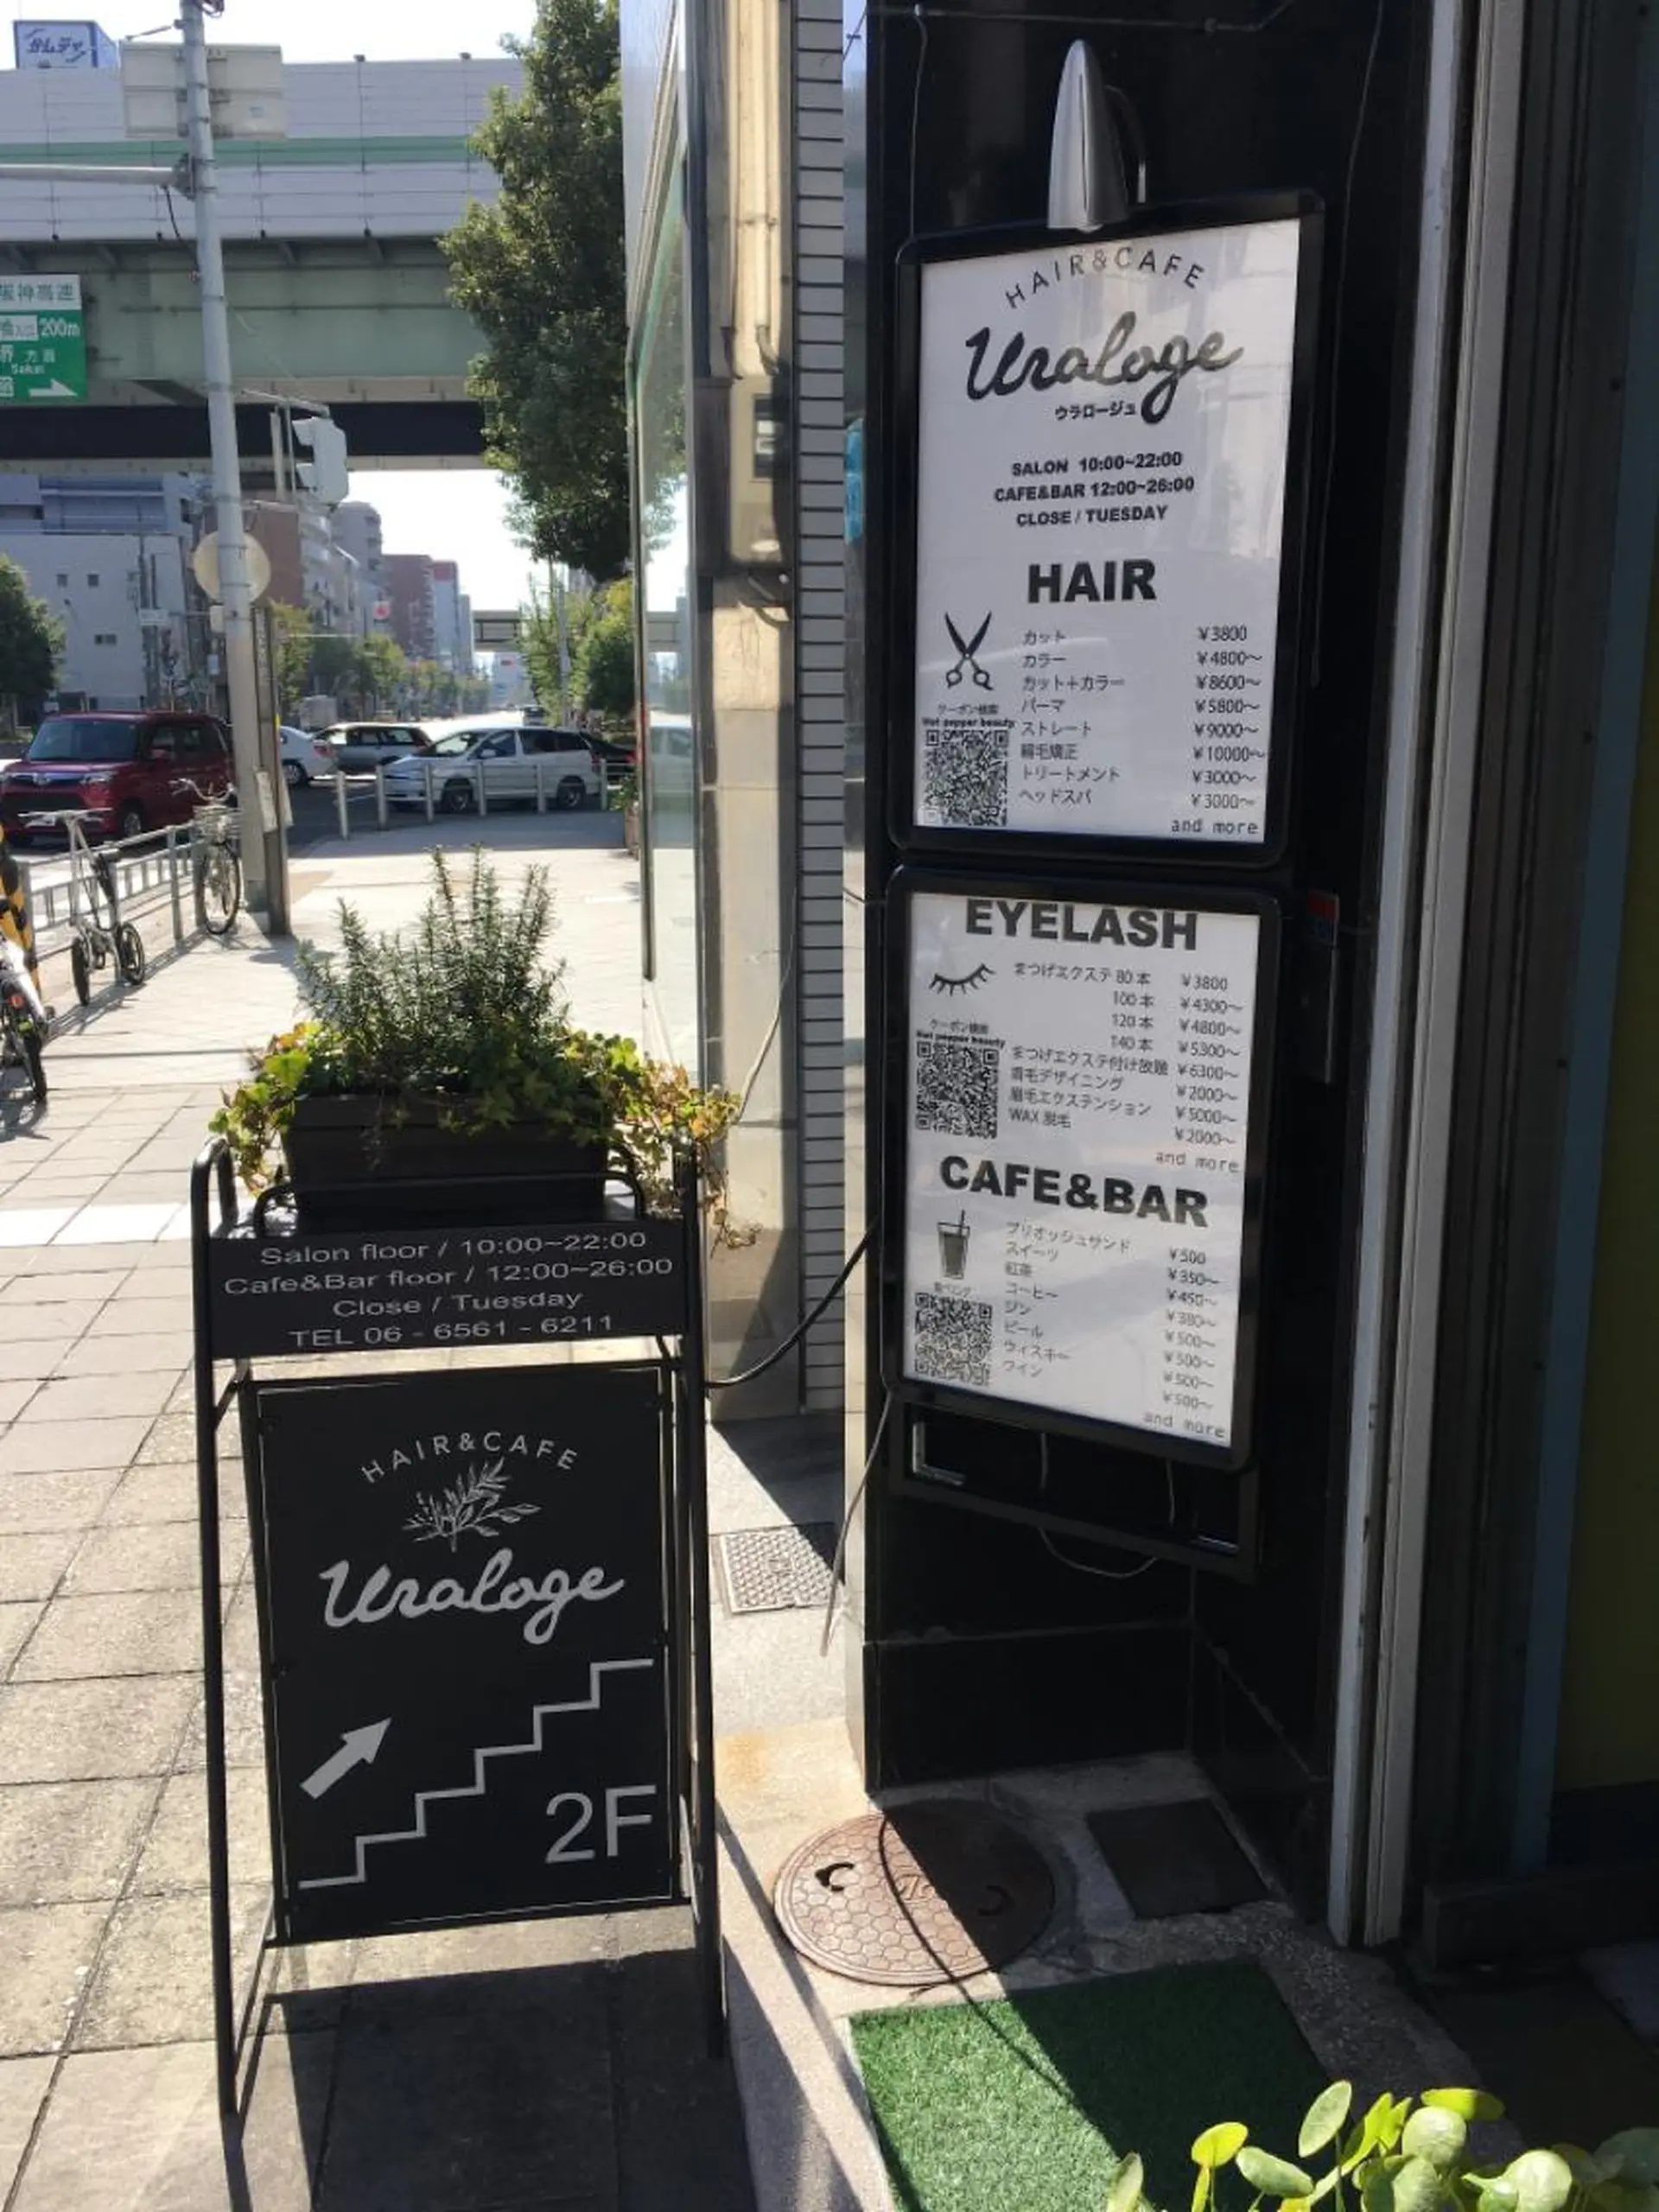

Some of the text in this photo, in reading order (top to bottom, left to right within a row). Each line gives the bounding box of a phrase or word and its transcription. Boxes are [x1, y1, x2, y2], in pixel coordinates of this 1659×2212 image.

[1004, 245, 1205, 309] HAIR&CAFE
[39, 317, 80, 337] 200m
[965, 310, 1244, 424] Uraloge
[1055, 401, 1136, 421] ウラロージュ
[1012, 452, 1183, 476] SALON 10:00~22:00
[994, 477, 1194, 502] CAFE&BAR 12:00~26:00
[1016, 510, 1071, 527] CLOSE
[1085, 505, 1169, 523] TUESDAY
[1027, 558, 1157, 604] HAIR
[1023, 629, 1066, 645] カット
[1022, 652, 1067, 668] カラー
[1172, 818, 1258, 835] and more
[965, 899, 1200, 950] EYELASH
[1195, 1157, 1239, 1172] more
[940, 1155, 1208, 1228] CAFE&BAR
[261, 1245, 349, 1266] Salon
[362, 1243, 429, 1260] floor
[224, 1273, 376, 1295] Cafe&Bar
[390, 1269, 456, 1286] floor
[334, 1300, 422, 1319] Close
[456, 1291, 584, 1312] Tuesday
[289, 1329, 354, 1349] TEL
[365, 1326, 404, 1345] 06
[434, 1320, 507, 1340] 6561
[541, 1315, 613, 1333] 6211
[360, 1432, 578, 1484] HAIR&CAFE
[318, 1548, 626, 1645] Uraloge
[544, 1784, 657, 1864] 2F
